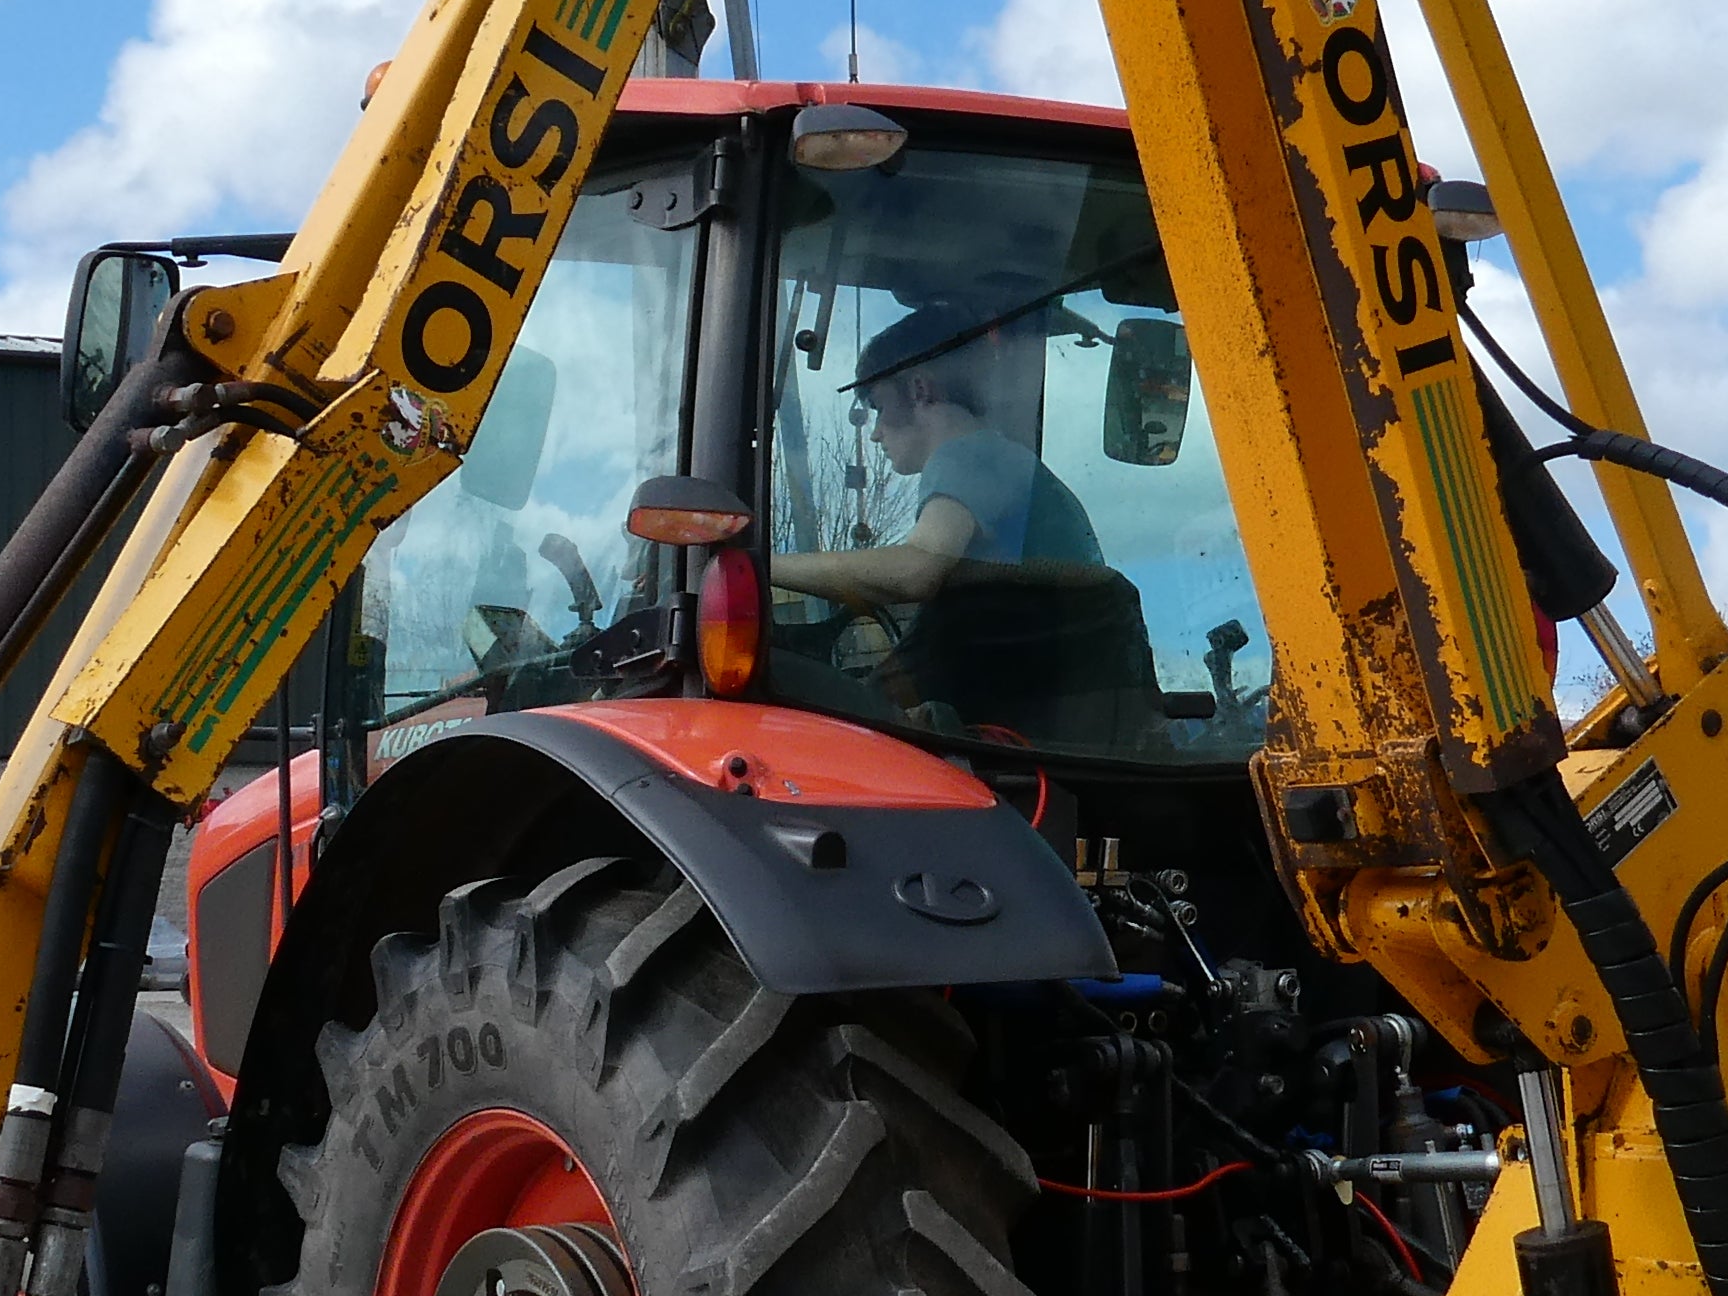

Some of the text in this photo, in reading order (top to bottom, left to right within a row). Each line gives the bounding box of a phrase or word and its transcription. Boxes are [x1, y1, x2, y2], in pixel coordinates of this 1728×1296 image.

[401, 20, 608, 394] ORSI
[1321, 26, 1458, 381] ORSI
[373, 717, 473, 761] KUBO
